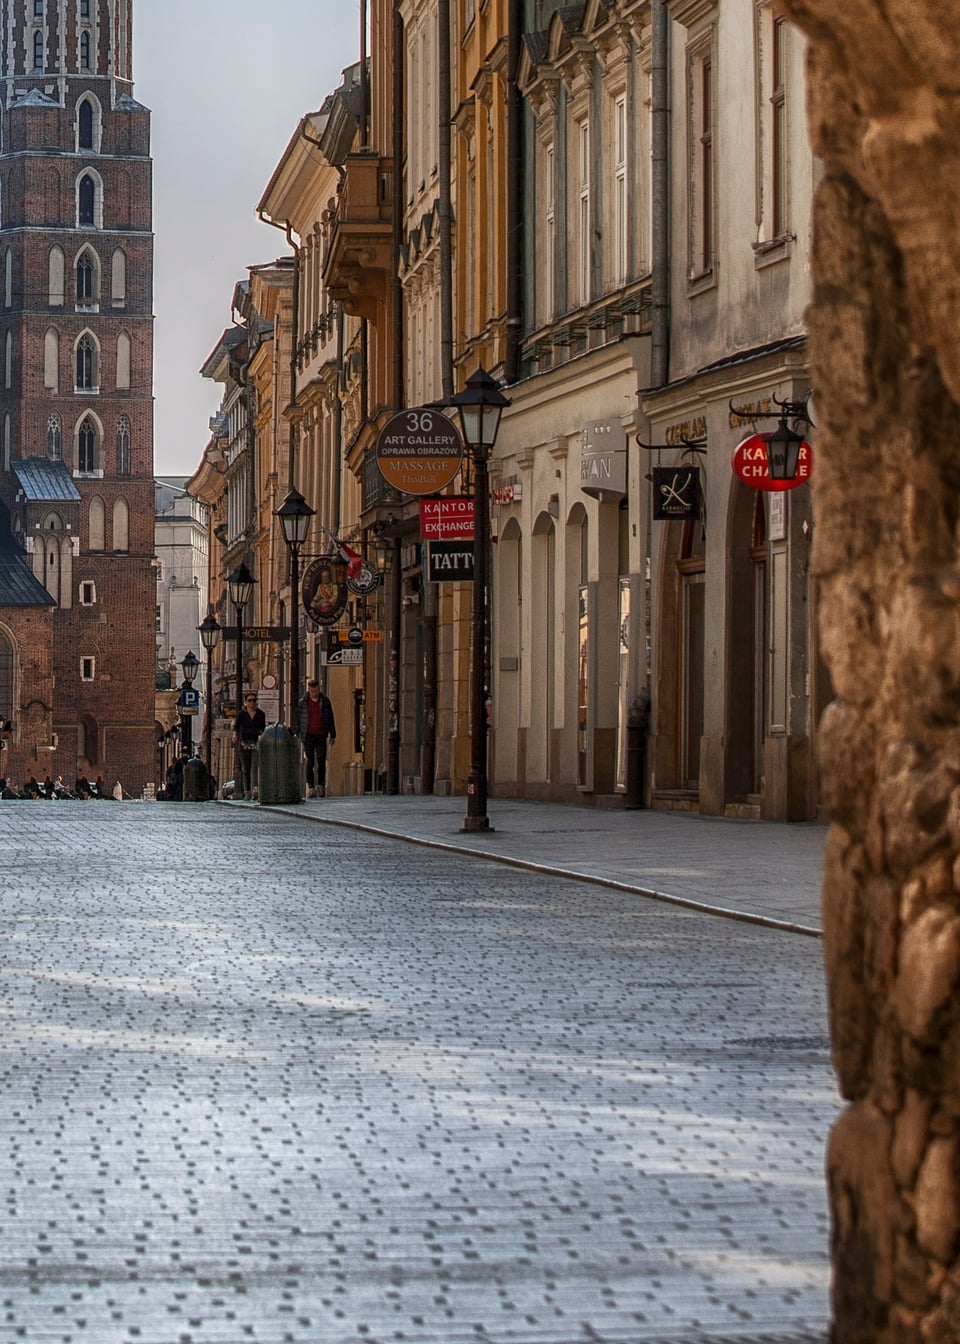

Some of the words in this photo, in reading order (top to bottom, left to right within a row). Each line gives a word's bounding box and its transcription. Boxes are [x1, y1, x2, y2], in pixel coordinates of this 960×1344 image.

[406, 412, 433, 432] 36
[384, 436, 405, 445] ART
[407, 436, 455, 445] GALLERY
[381, 447, 416, 455] OPRAWA
[417, 446, 458, 455] OBRAZÓW
[743, 448, 807, 460] KAR
[390, 461, 449, 471] MASSAGE
[424, 503, 474, 513] KANTOR
[425, 521, 474, 532] EXCHANGE
[432, 553, 475, 569] TATT
[242, 629, 271, 638] HOTEL
[185, 692, 195, 705] P
